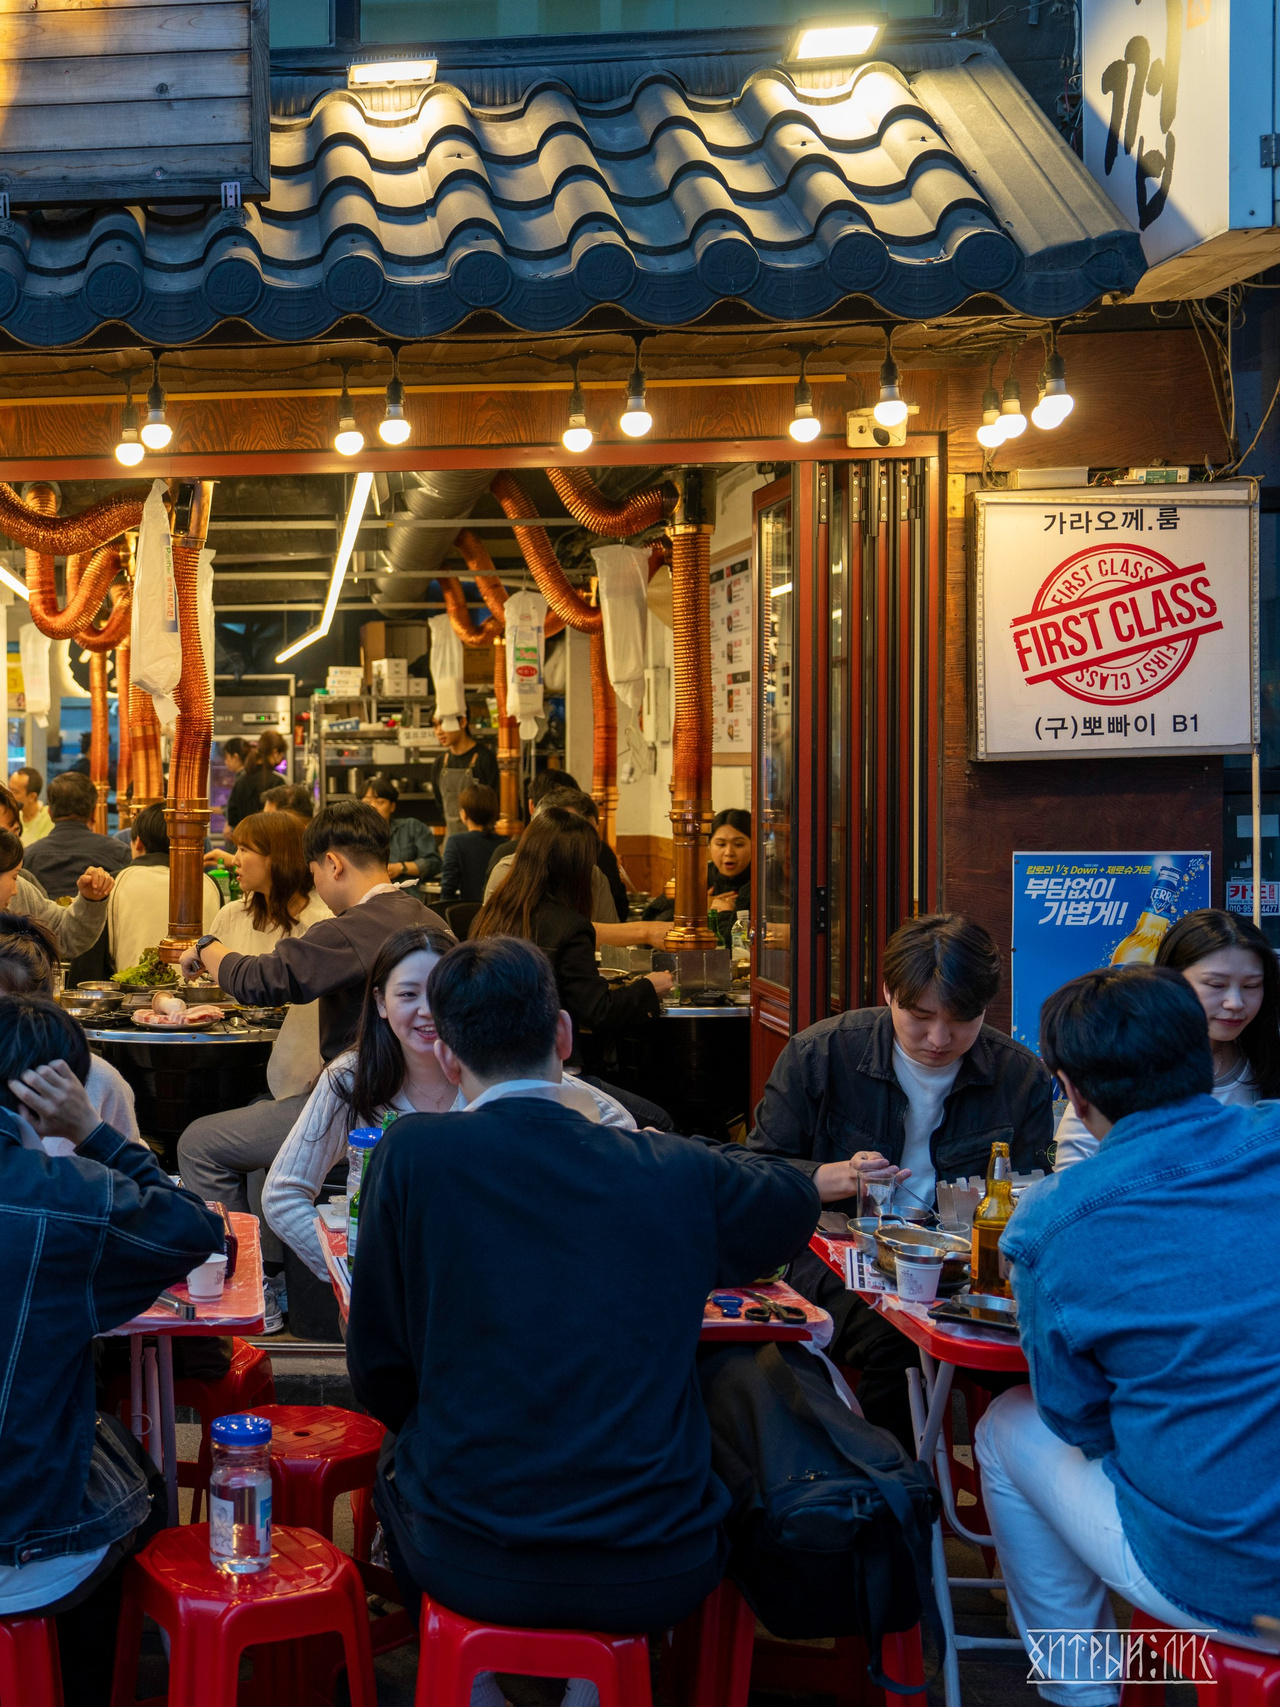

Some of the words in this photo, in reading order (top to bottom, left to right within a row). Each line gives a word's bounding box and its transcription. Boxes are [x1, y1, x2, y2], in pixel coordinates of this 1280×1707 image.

[1043, 507, 1181, 535] 가라오께.룸
[1051, 564, 1094, 607] FIRST
[1098, 558, 1154, 582] CLASS
[1013, 606, 1102, 673] FIRST
[1108, 576, 1218, 643] CLASS
[1139, 642, 1179, 687] FIRST
[1075, 666, 1132, 691] CLASS
[1035, 713, 1157, 740] (구)뽀빠이
[1172, 713, 1199, 732] B1
[1070, 865, 1097, 875] Down
[1105, 865, 1153, 875] 제로슈거로
[1024, 878, 1117, 900] 부담없이
[1151, 888, 1174, 903] TERRA
[1038, 901, 1128, 926] 가볍게!
